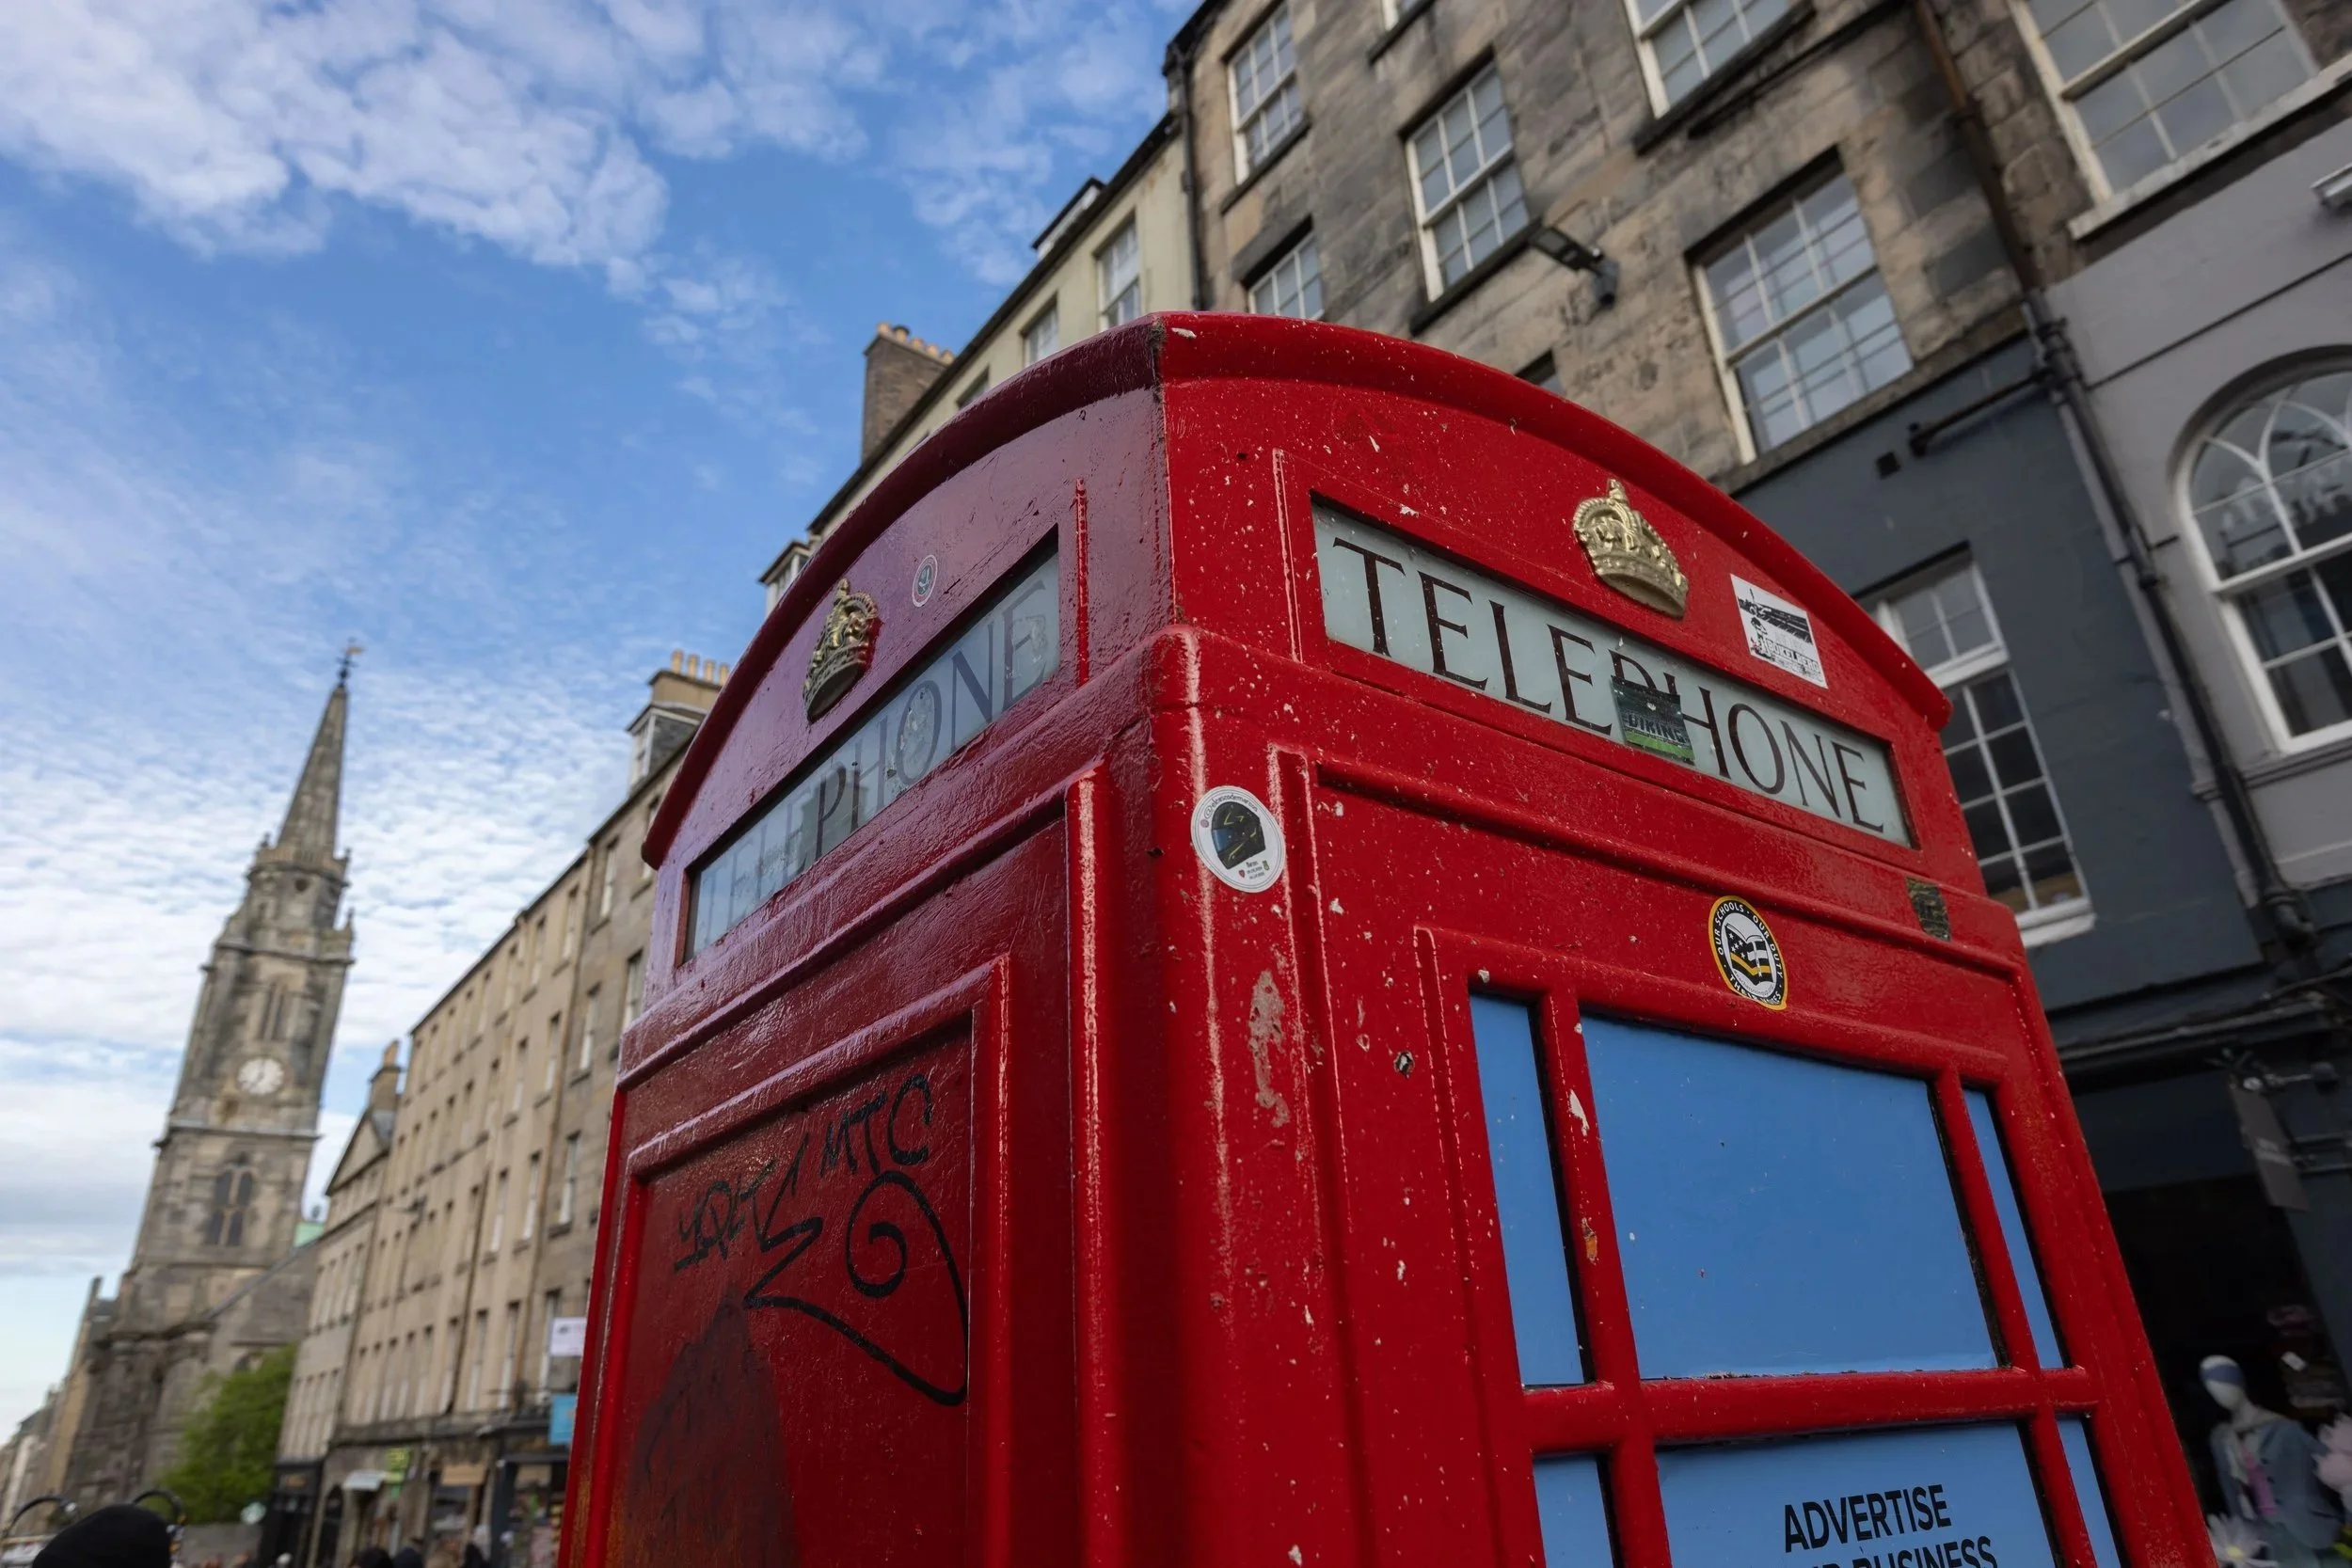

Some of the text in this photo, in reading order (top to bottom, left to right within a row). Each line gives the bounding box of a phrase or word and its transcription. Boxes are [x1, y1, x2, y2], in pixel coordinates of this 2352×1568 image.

[698, 578, 1047, 943] TELEPHONE
[1715, 902, 1744, 926] SCHOOLS
[1753, 915, 1769, 939] OUR
[1714, 929, 1724, 955] OUR
[1770, 943, 1783, 978] DUTY
[1785, 1484, 1951, 1553] ADVERTISE
[1852, 1536, 1998, 1568] NESS
